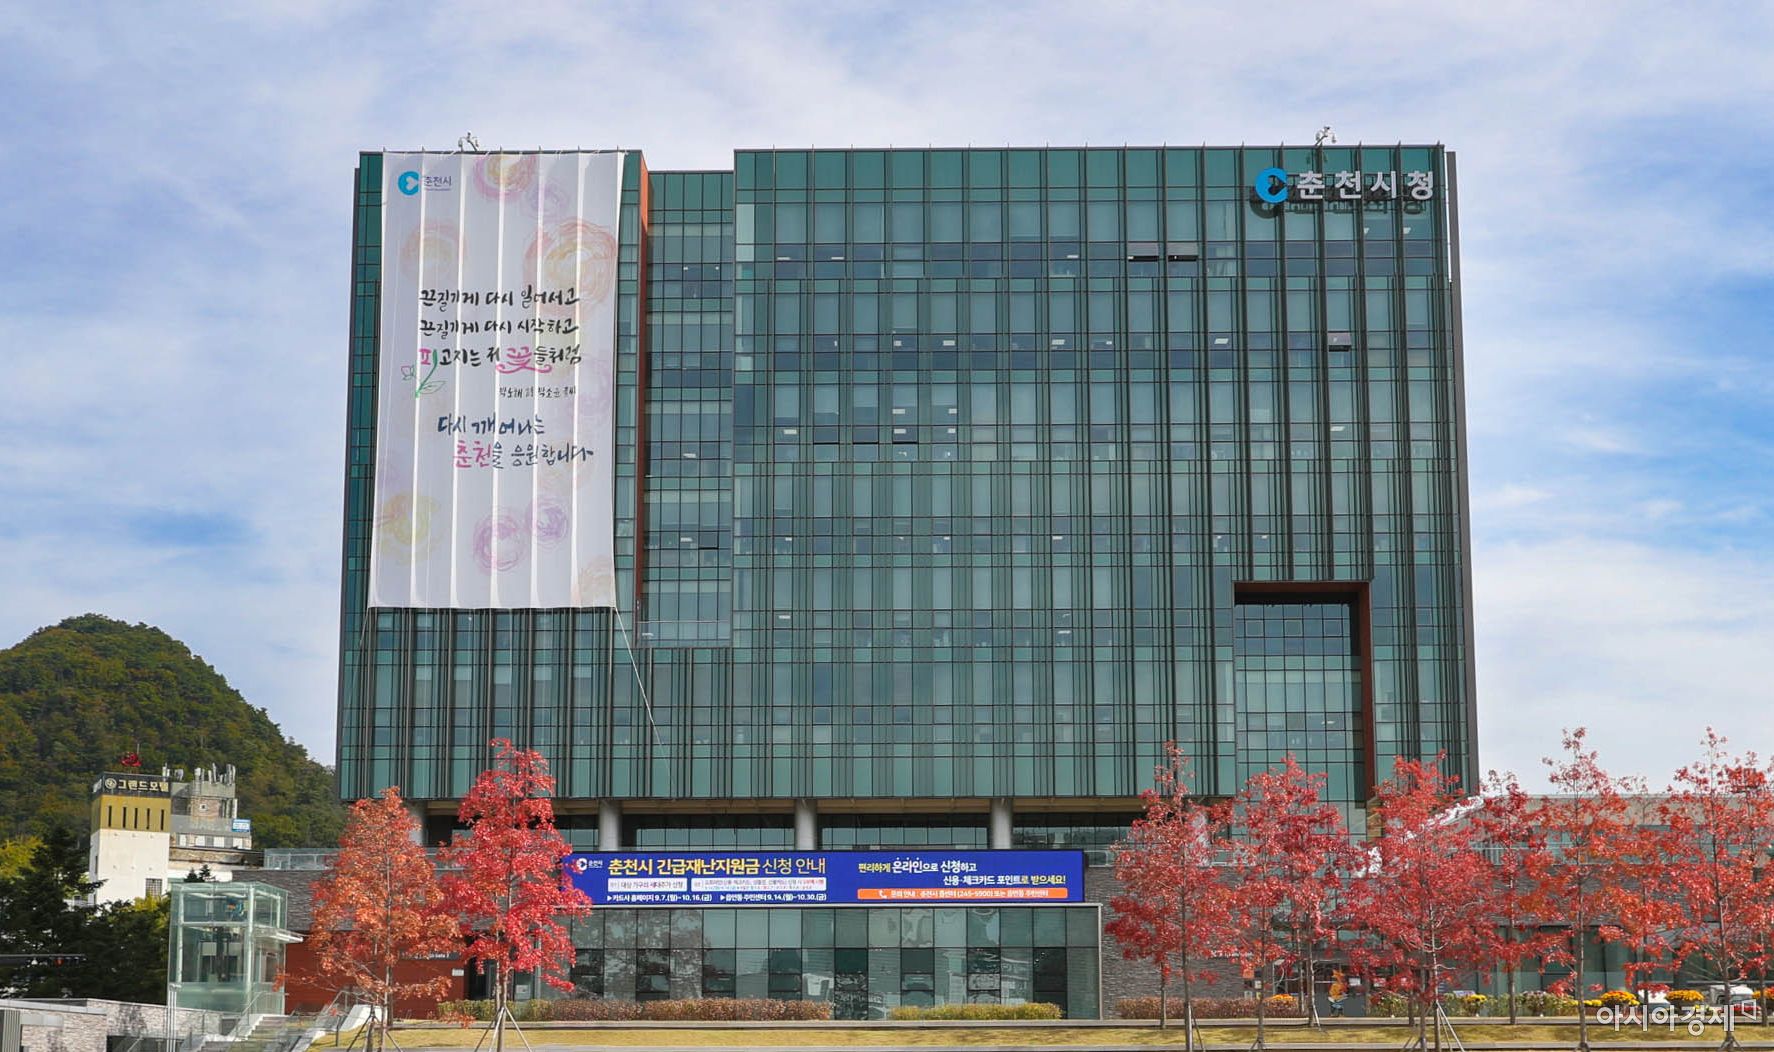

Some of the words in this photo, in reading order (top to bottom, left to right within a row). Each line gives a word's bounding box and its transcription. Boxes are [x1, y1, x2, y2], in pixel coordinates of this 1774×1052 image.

[1297, 170, 1434, 201] 춘천시청
[420, 289, 479, 312] 끈질기게
[485, 291, 513, 306] 다시
[521, 284, 580, 309] 일어서고
[420, 319, 479, 340] 끈질기게
[484, 319, 512, 334] 다시
[517, 317, 579, 335] 시작하고
[437, 412, 466, 435] 다시
[471, 411, 545, 435] 깨어나는
[453, 440, 504, 470] 춘천을
[511, 442, 594, 467] 응원합니다
[608, 858, 653, 876] 춘천시
[656, 858, 760, 876] 긴급재난지원금
[762, 858, 792, 874] 신청
[795, 857, 826, 874] 안내
[858, 862, 891, 873] 편리하게
[892, 857, 939, 874] 온라인으로
[940, 860, 977, 873] 신청하고
